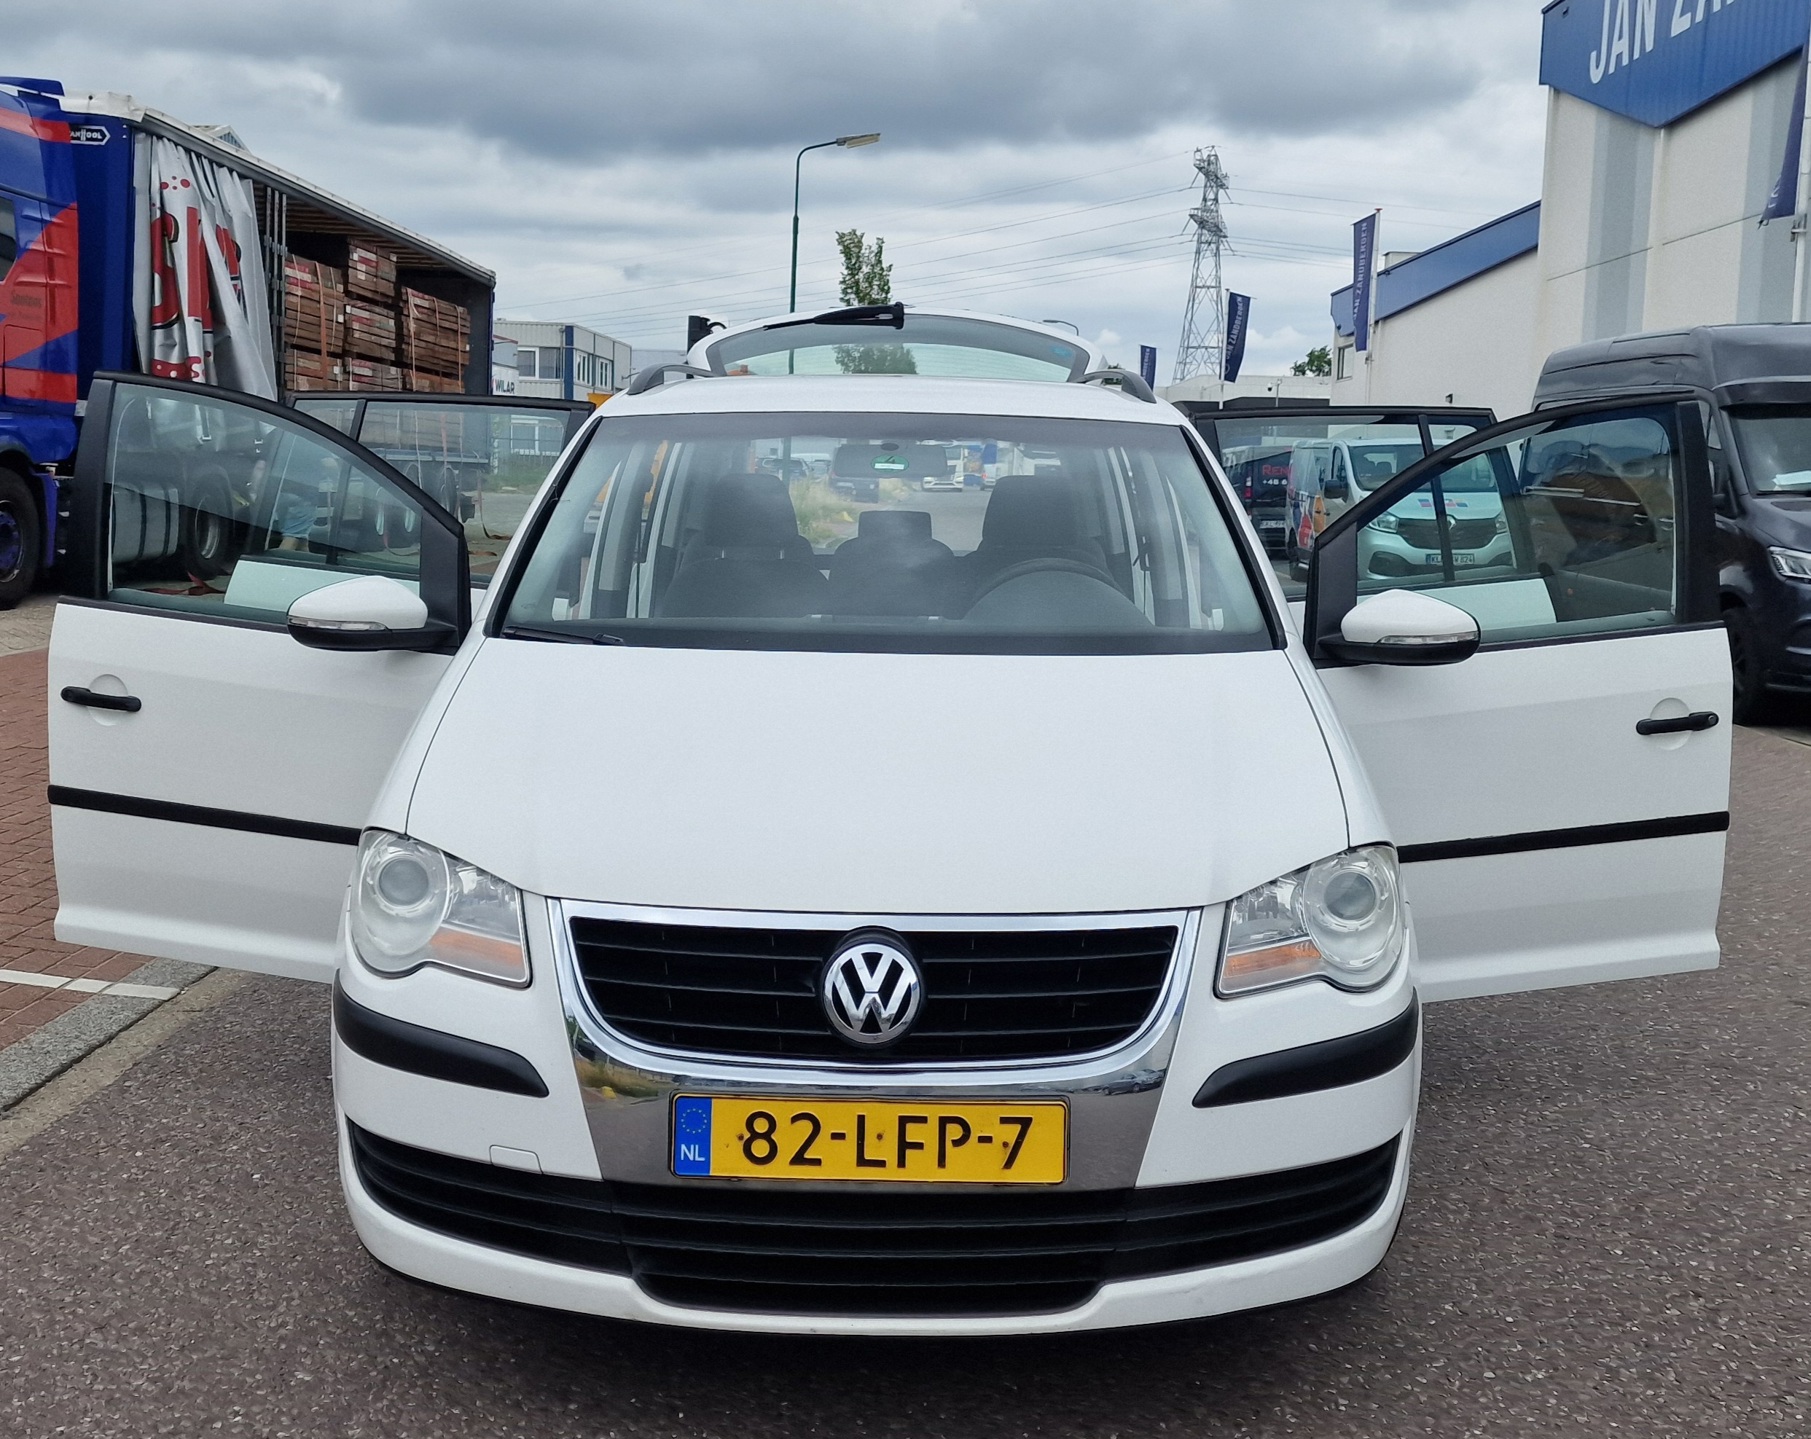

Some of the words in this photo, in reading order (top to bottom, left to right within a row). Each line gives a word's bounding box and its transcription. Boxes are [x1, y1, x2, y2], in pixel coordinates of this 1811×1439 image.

[1589, 0, 1657, 84] JAN
[69, 129, 103, 142] ANHOOL
[1262, 464, 1291, 476] REN
[828, 946, 916, 1040] VW
[680, 1144, 706, 1162] NL
[742, 1110, 1034, 1170] 82-LFP-7
